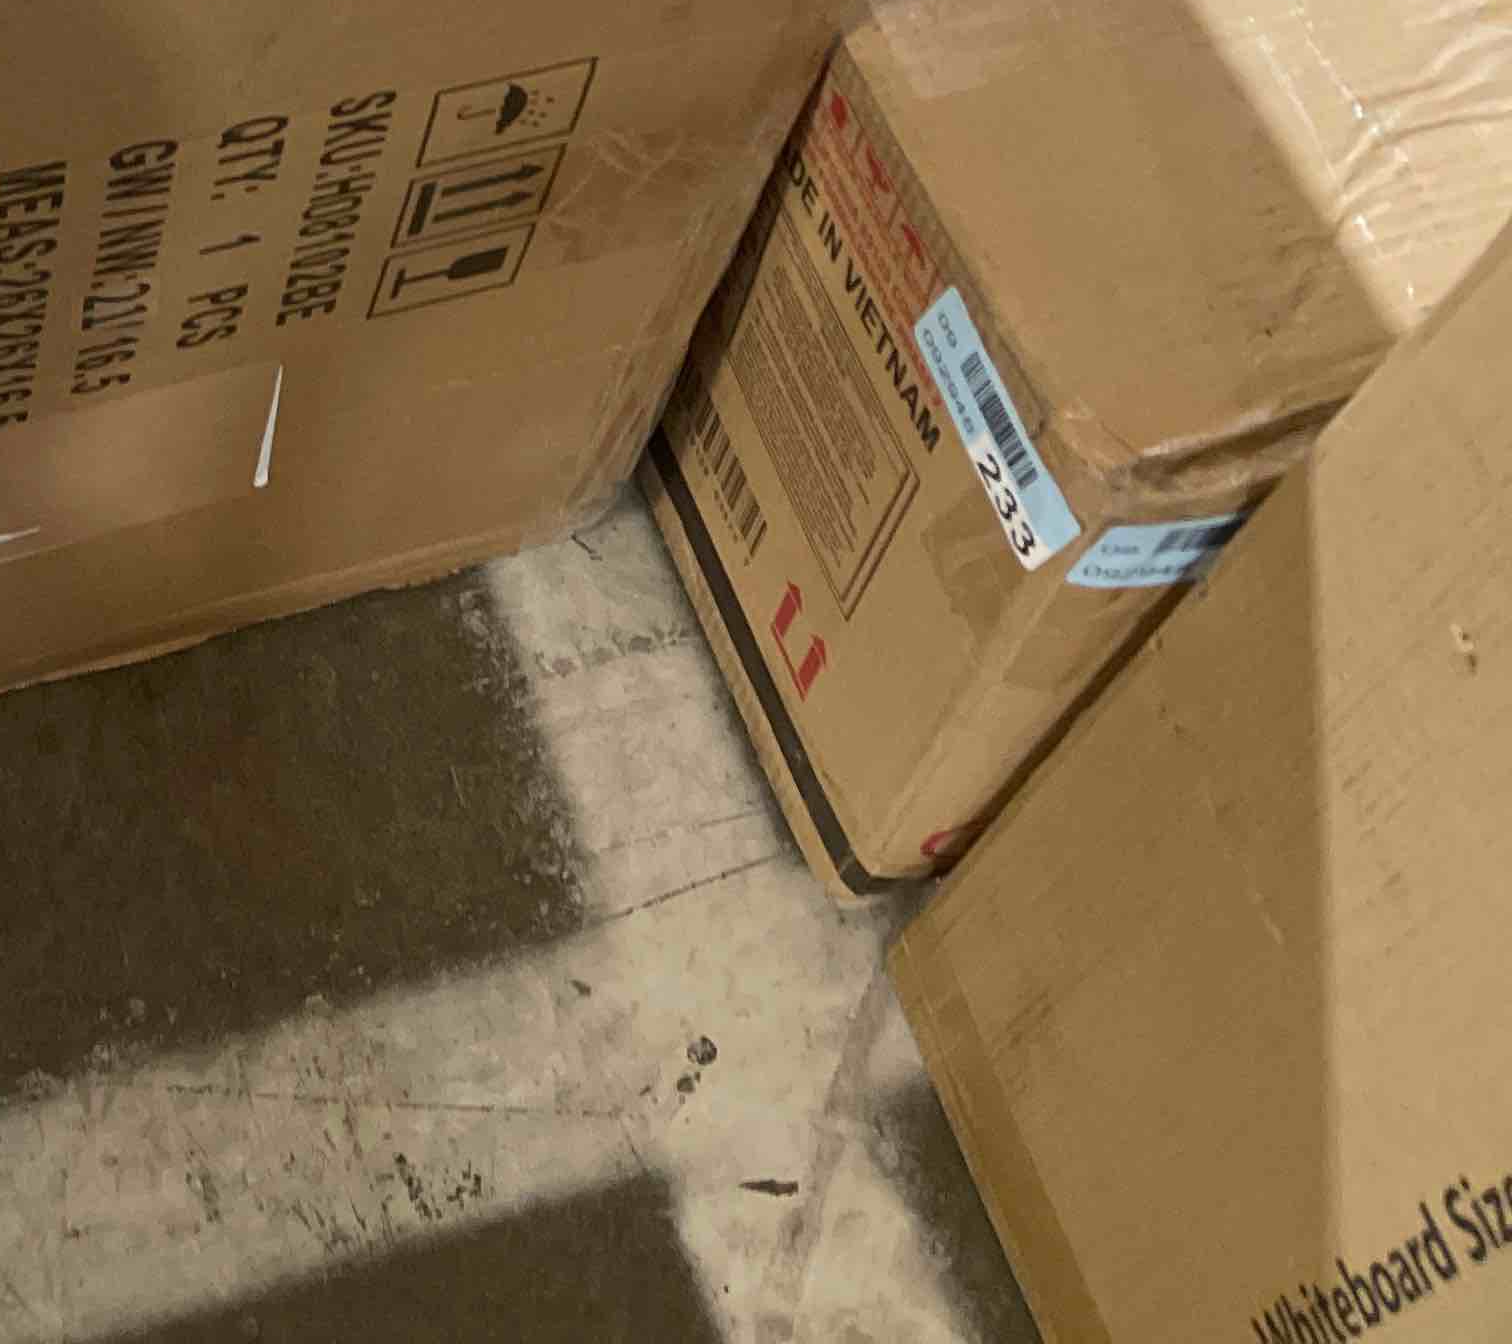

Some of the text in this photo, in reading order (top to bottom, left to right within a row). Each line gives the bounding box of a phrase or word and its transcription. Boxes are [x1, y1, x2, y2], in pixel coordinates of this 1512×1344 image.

[176, 114, 290, 351] QTY: 1 PCS
[276, 88, 397, 327] SKU:H08102BE
[817, 211, 843, 264] IN
[842, 261, 942, 455] VIETNAM
[976, 453, 1037, 558] 233
[1250, 1201, 1458, 1344] Whiteboard
